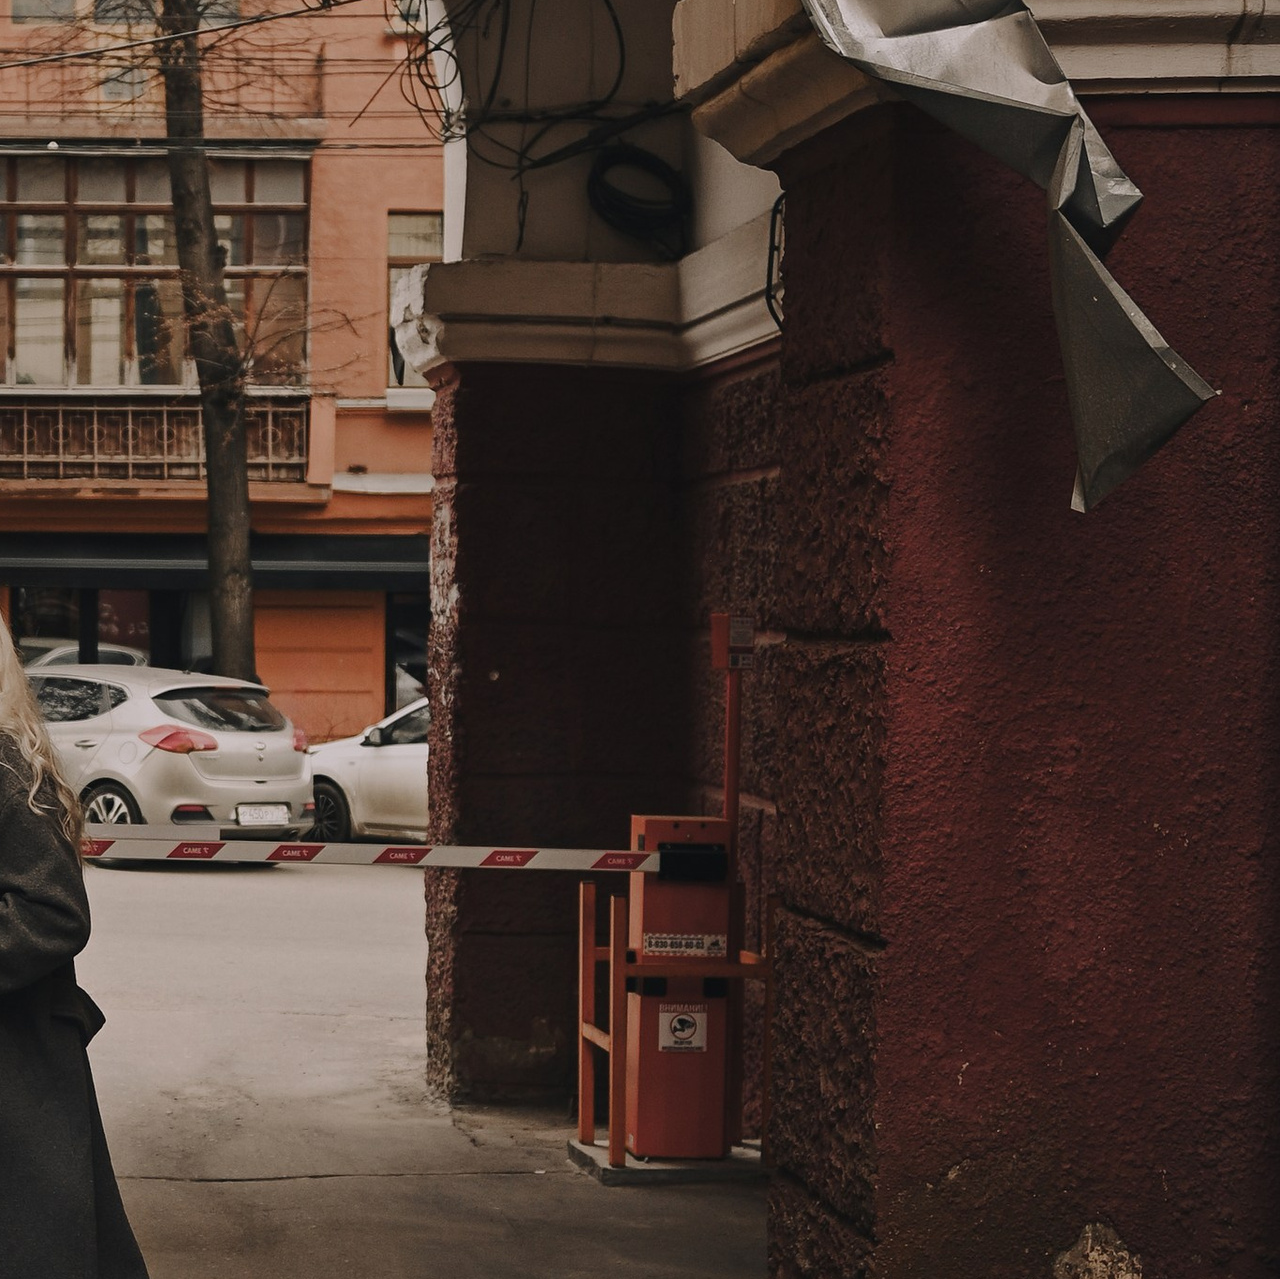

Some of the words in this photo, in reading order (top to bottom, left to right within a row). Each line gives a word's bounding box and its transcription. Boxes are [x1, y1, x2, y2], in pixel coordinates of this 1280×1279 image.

[282, 849, 301, 857] CAME
[389, 852, 408, 860] CAME
[495, 855, 515, 863] CAME
